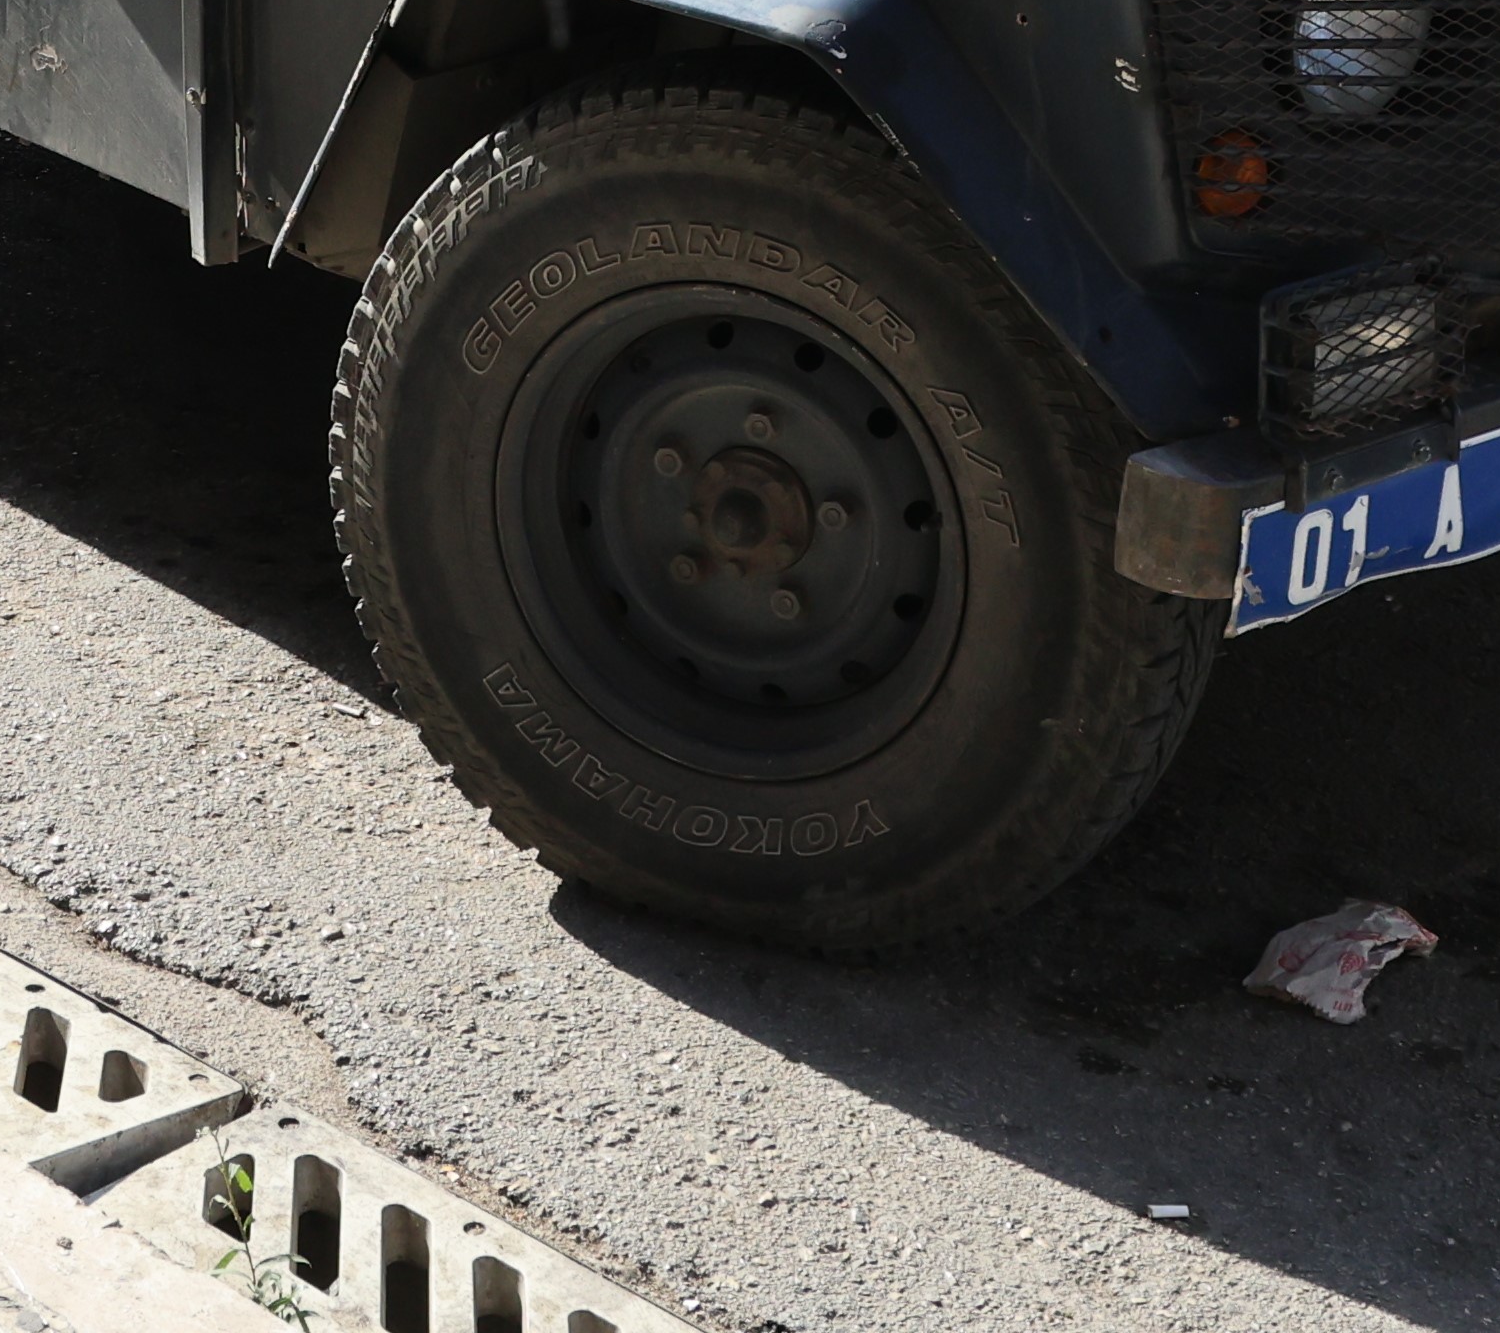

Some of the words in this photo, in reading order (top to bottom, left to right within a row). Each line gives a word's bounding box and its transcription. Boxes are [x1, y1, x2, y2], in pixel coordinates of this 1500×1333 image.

[463, 223, 915, 375] GEOLANDAR
[927, 386, 1020, 547] A/T
[1287, 494, 1370, 605] 01
[1423, 463, 1464, 560] A
[483, 662, 891, 856] YOKOHAMA
